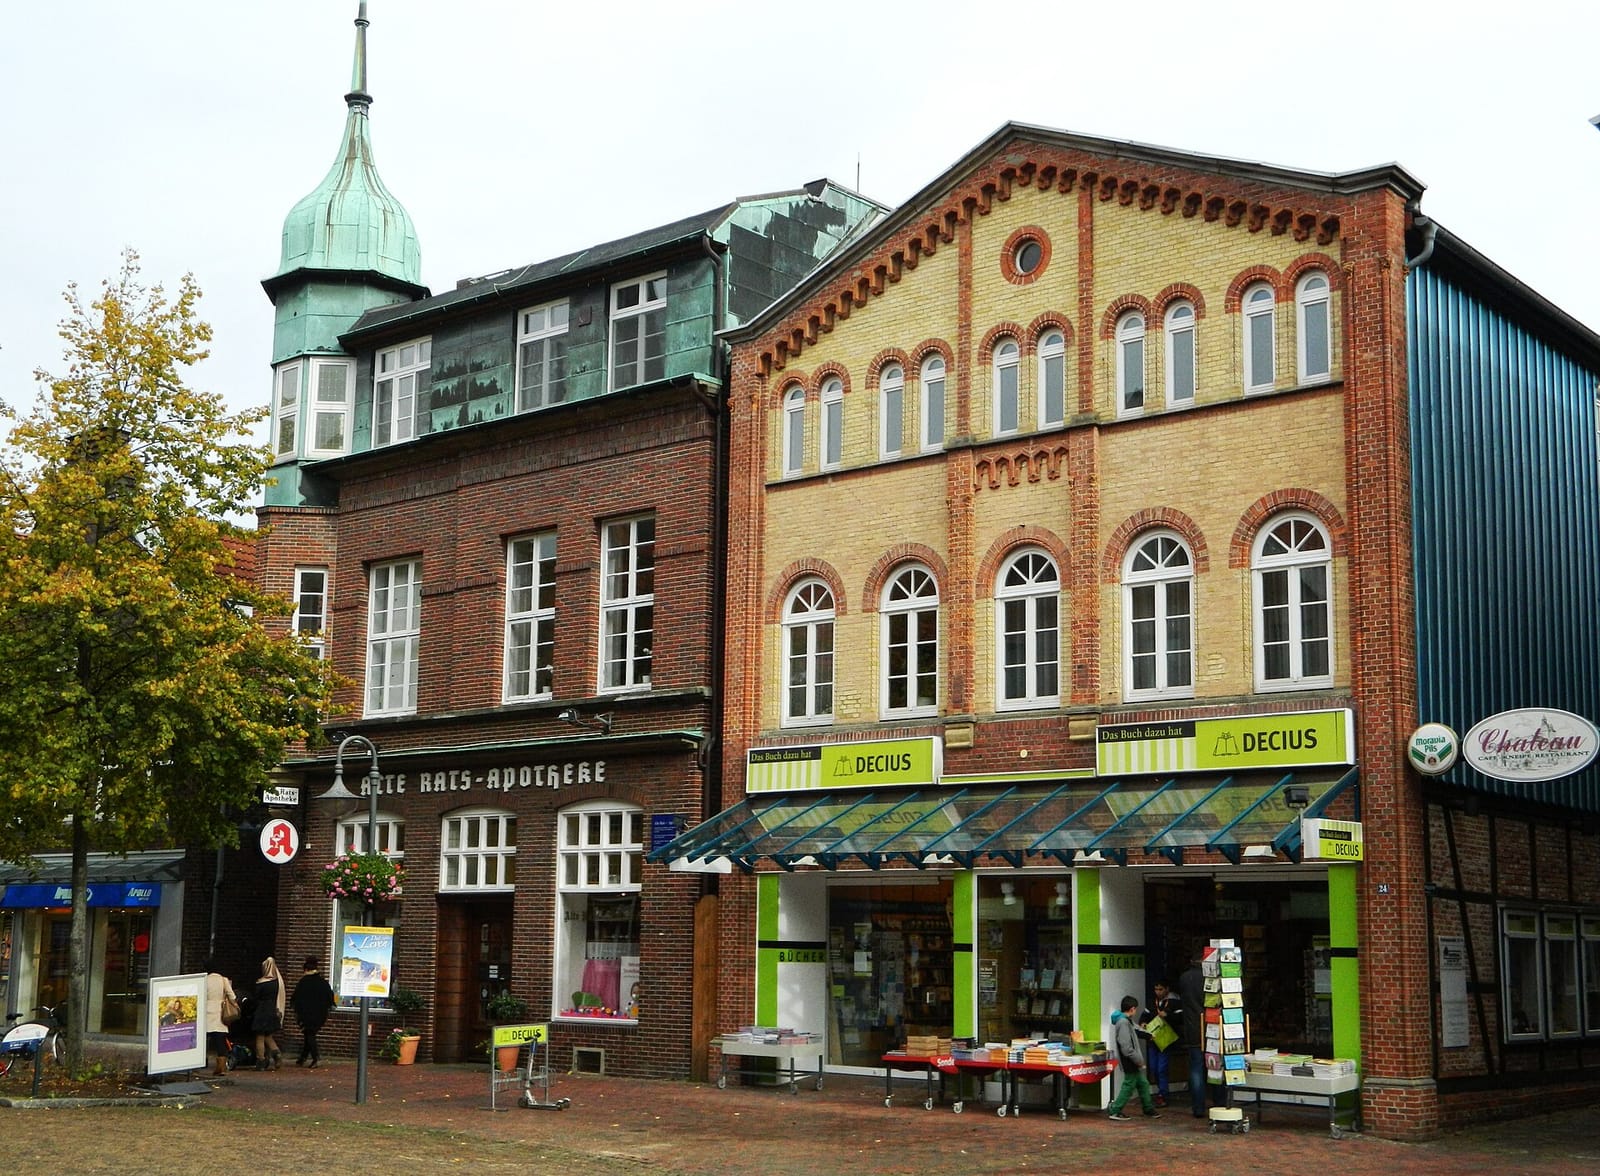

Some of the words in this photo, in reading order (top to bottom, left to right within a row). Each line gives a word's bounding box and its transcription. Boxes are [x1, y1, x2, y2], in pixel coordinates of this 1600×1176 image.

[1102, 730, 1118, 740] Das
[1121, 728, 1142, 739] Buch
[1144, 727, 1166, 737] dazu
[1168, 725, 1182, 736] hat
[1243, 728, 1318, 752] DECIUS
[1478, 727, 1586, 754] Chateau
[751, 753, 764, 761] Das
[765, 751, 782, 760] Buch
[783, 750, 799, 760] dazu
[801, 749, 812, 758] hat
[1424, 744, 1438, 753] Pils
[1535, 750, 1590, 759] RESTAURANT
[856, 753, 911, 773] DECIUS
[360, 773, 407, 796] ALTE
[265, 794, 297, 802] Apotheke
[1335, 843, 1359, 857] DECIUS
[1378, 884, 1388, 893] 24
[779, 949, 825, 962] BÜCHER
[512, 1029, 541, 1040] DECIUS
